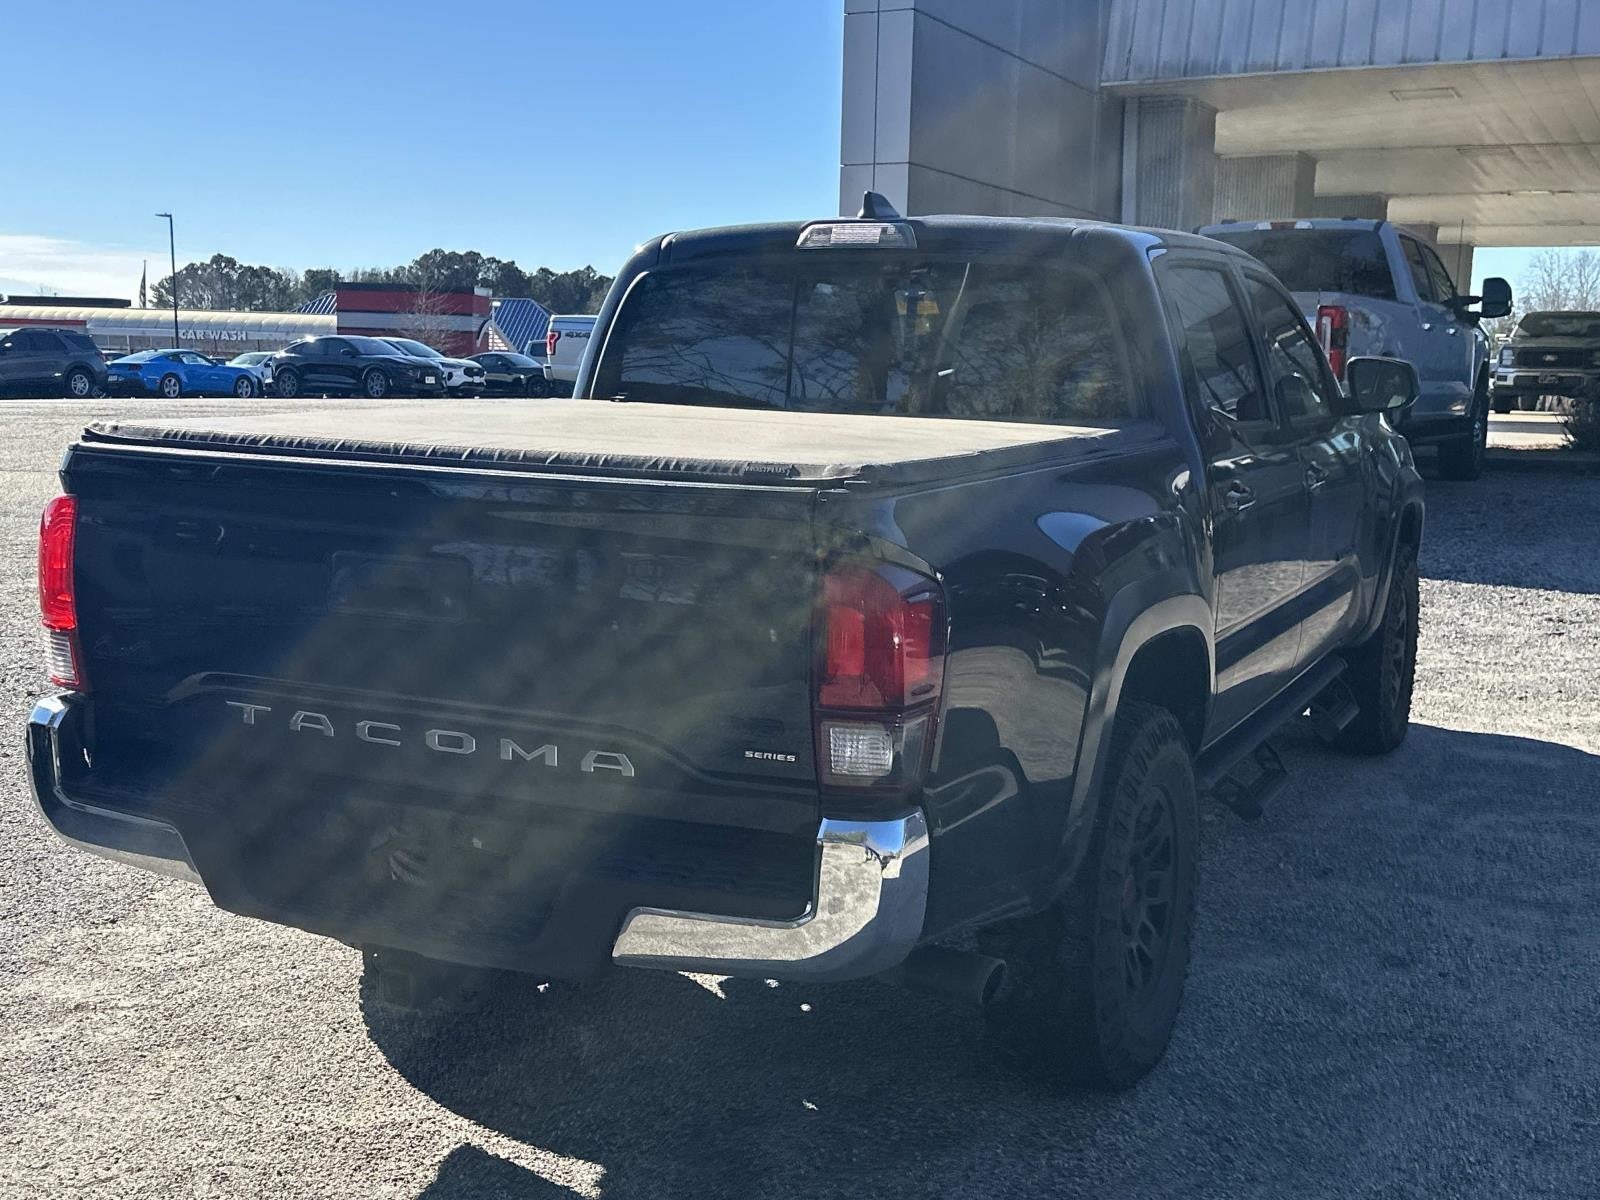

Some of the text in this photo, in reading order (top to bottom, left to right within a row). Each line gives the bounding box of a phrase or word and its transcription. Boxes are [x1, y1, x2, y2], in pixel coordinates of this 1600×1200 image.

[179, 329, 247, 341] CAR WASH
[225, 700, 636, 778] TACOMA
[744, 751, 796, 762] SERIES
